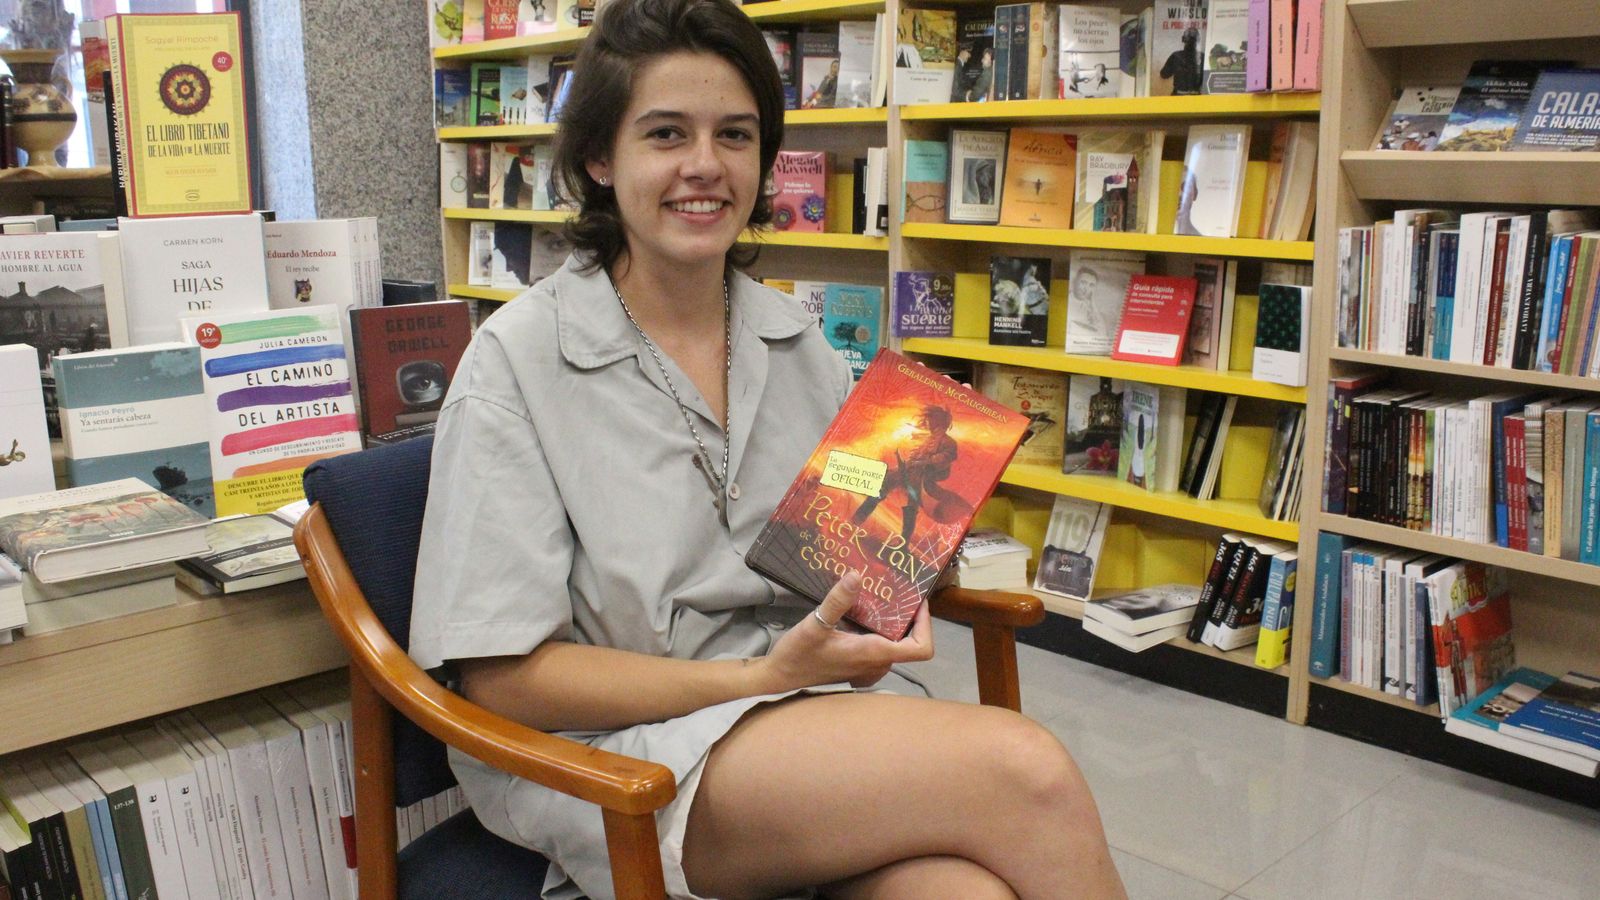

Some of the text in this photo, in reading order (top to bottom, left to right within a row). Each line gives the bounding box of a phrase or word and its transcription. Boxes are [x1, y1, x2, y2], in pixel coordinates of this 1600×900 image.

[1074, 17, 1108, 30] Los peces
[1085, 28, 1109, 36] cierran
[1078, 36, 1088, 44] los
[1531, 115, 1550, 128] DE
[147, 122, 229, 142] EL LIBRO TIBETANO
[148, 142, 231, 157] DE LA VIDA LA MUERTE
[780, 155, 818, 166] Megan
[776, 164, 822, 174] Maxwell
[163, 237, 224, 247] CARMEN KORN
[33, 249, 85, 260] REVERTE
[266, 250, 337, 259] Eduardo Mendoza
[1, 263, 83, 273] HOMBRE AL AGUA
[181, 260, 212, 270] SAGA
[294, 266, 303, 274] rey
[304, 265, 320, 273] recibe
[172, 277, 224, 295] HIJAS
[1151, 284, 1175, 293] rápida
[811, 291, 826, 303] NO
[386, 315, 447, 333] GEORGE
[260, 335, 328, 349] JULIA CAMERON
[387, 337, 449, 354] ORWELL
[246, 363, 334, 386] EL CAMINO
[897, 363, 944, 391] GERALDINE
[80, 406, 135, 419] Ignacio Peyró
[238, 402, 341, 427] DEL ARTISTA
[93, 417, 124, 425] sentarás
[126, 413, 151, 421] cabeza
[829, 462, 883, 480] segunda parte
[228, 480, 259, 490] DESCUBRE
[268, 475, 286, 483] LIBRO
[831, 473, 873, 490] OFICIAL
[239, 486, 264, 494] TREINTA
[265, 482, 281, 490] AÑOS
[254, 490, 281, 498] ARTISTAS
